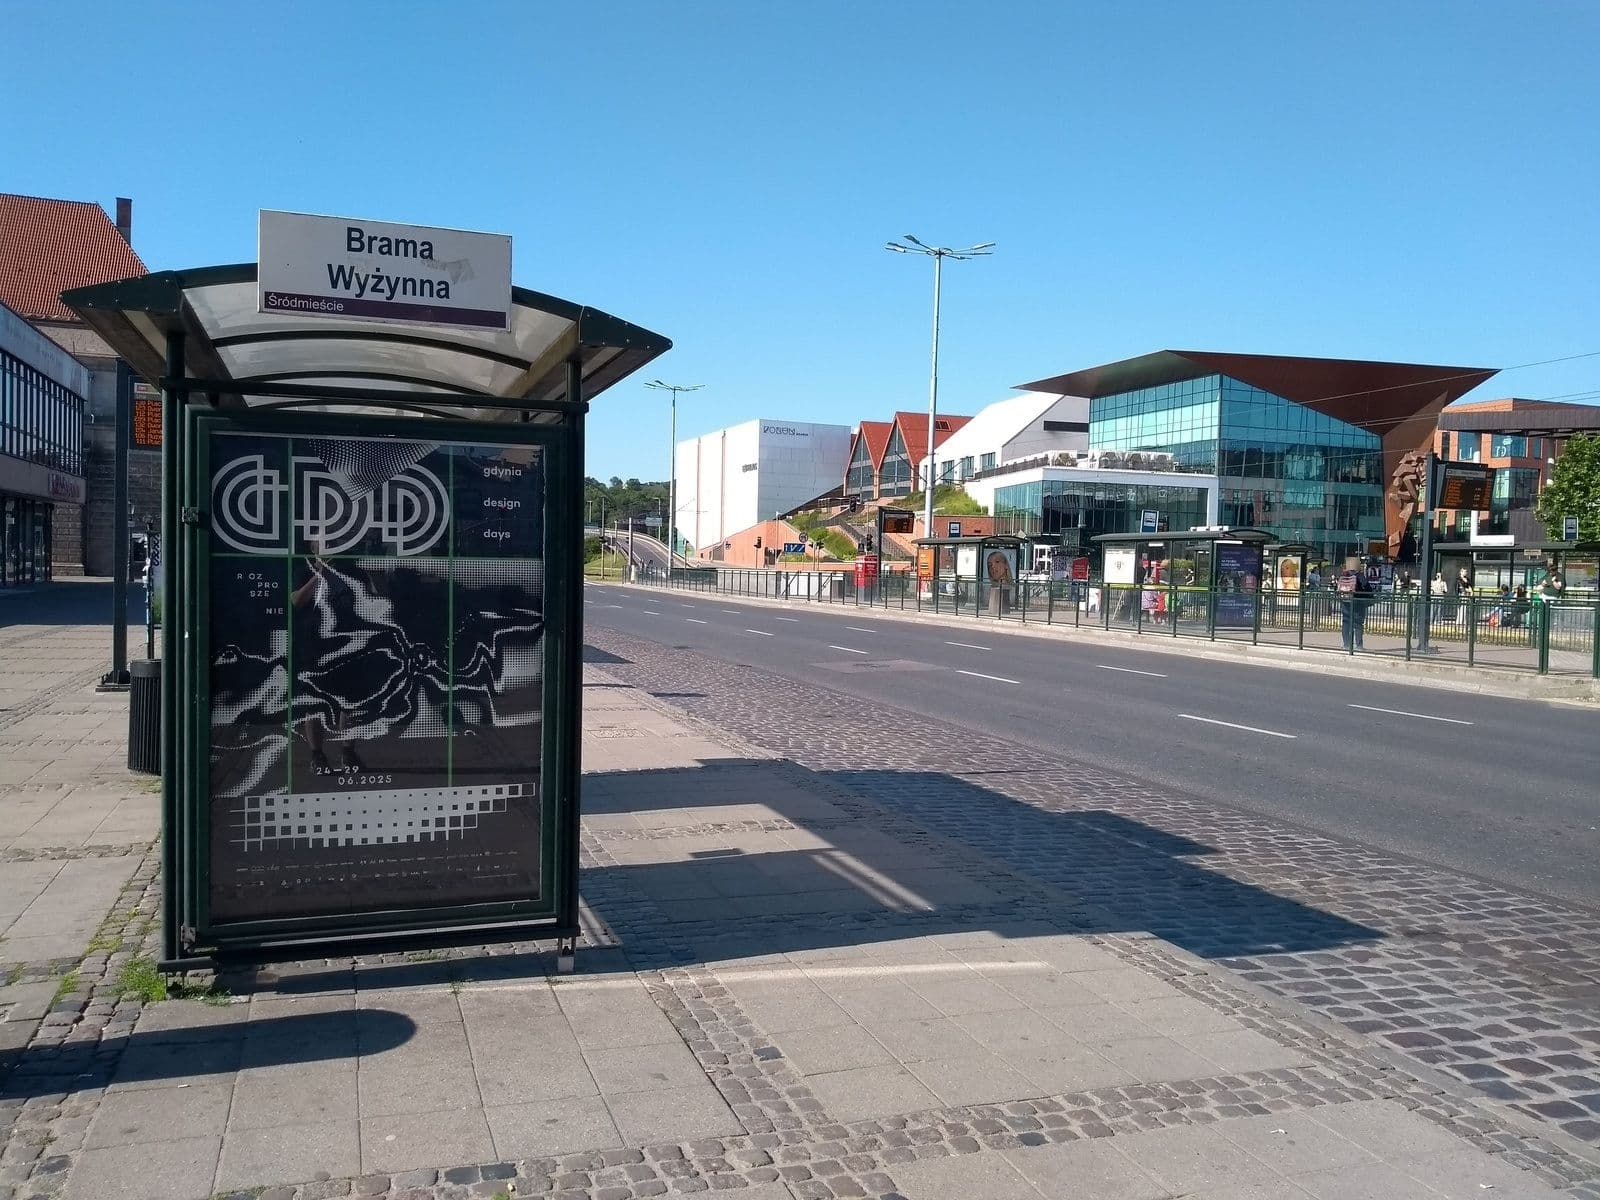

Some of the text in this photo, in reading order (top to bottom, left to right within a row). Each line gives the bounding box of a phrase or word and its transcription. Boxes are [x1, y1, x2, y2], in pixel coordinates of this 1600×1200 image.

[346, 226, 434, 260] Brama
[327, 263, 451, 301] Wyżynna
[267, 293, 344, 312] Śródmieście
[483, 466, 522, 478] gdynia
[483, 497, 521, 509] design
[483, 528, 511, 540] days
[257, 581, 279, 589] PRO
[265, 607, 284, 615] NIE
[337, 774, 393, 786] 06.2025
